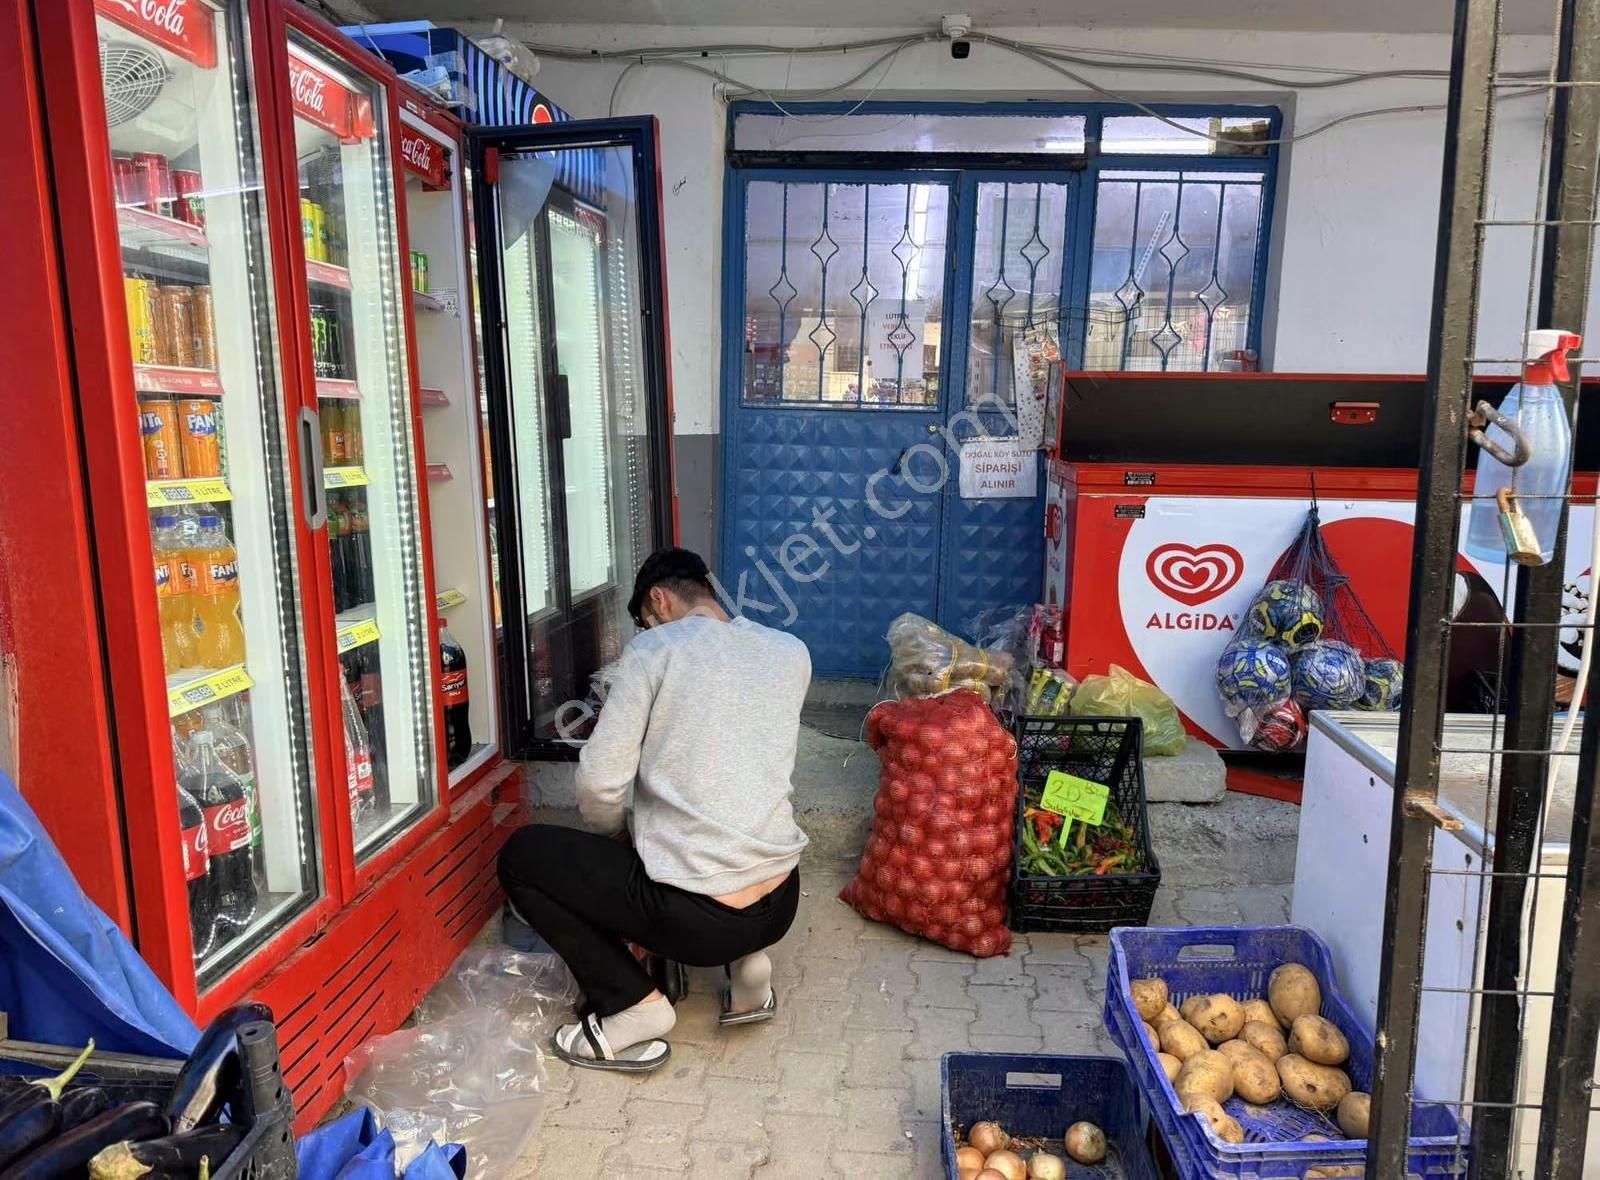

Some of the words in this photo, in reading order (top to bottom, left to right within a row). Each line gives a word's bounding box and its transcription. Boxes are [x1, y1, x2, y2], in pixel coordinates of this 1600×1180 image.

[885, 311, 910, 320] LÜTFN
[887, 333, 907, 341] EKLİF
[975, 463, 1022, 476] SİPARİŞİ
[980, 479, 1016, 490] ALINIR
